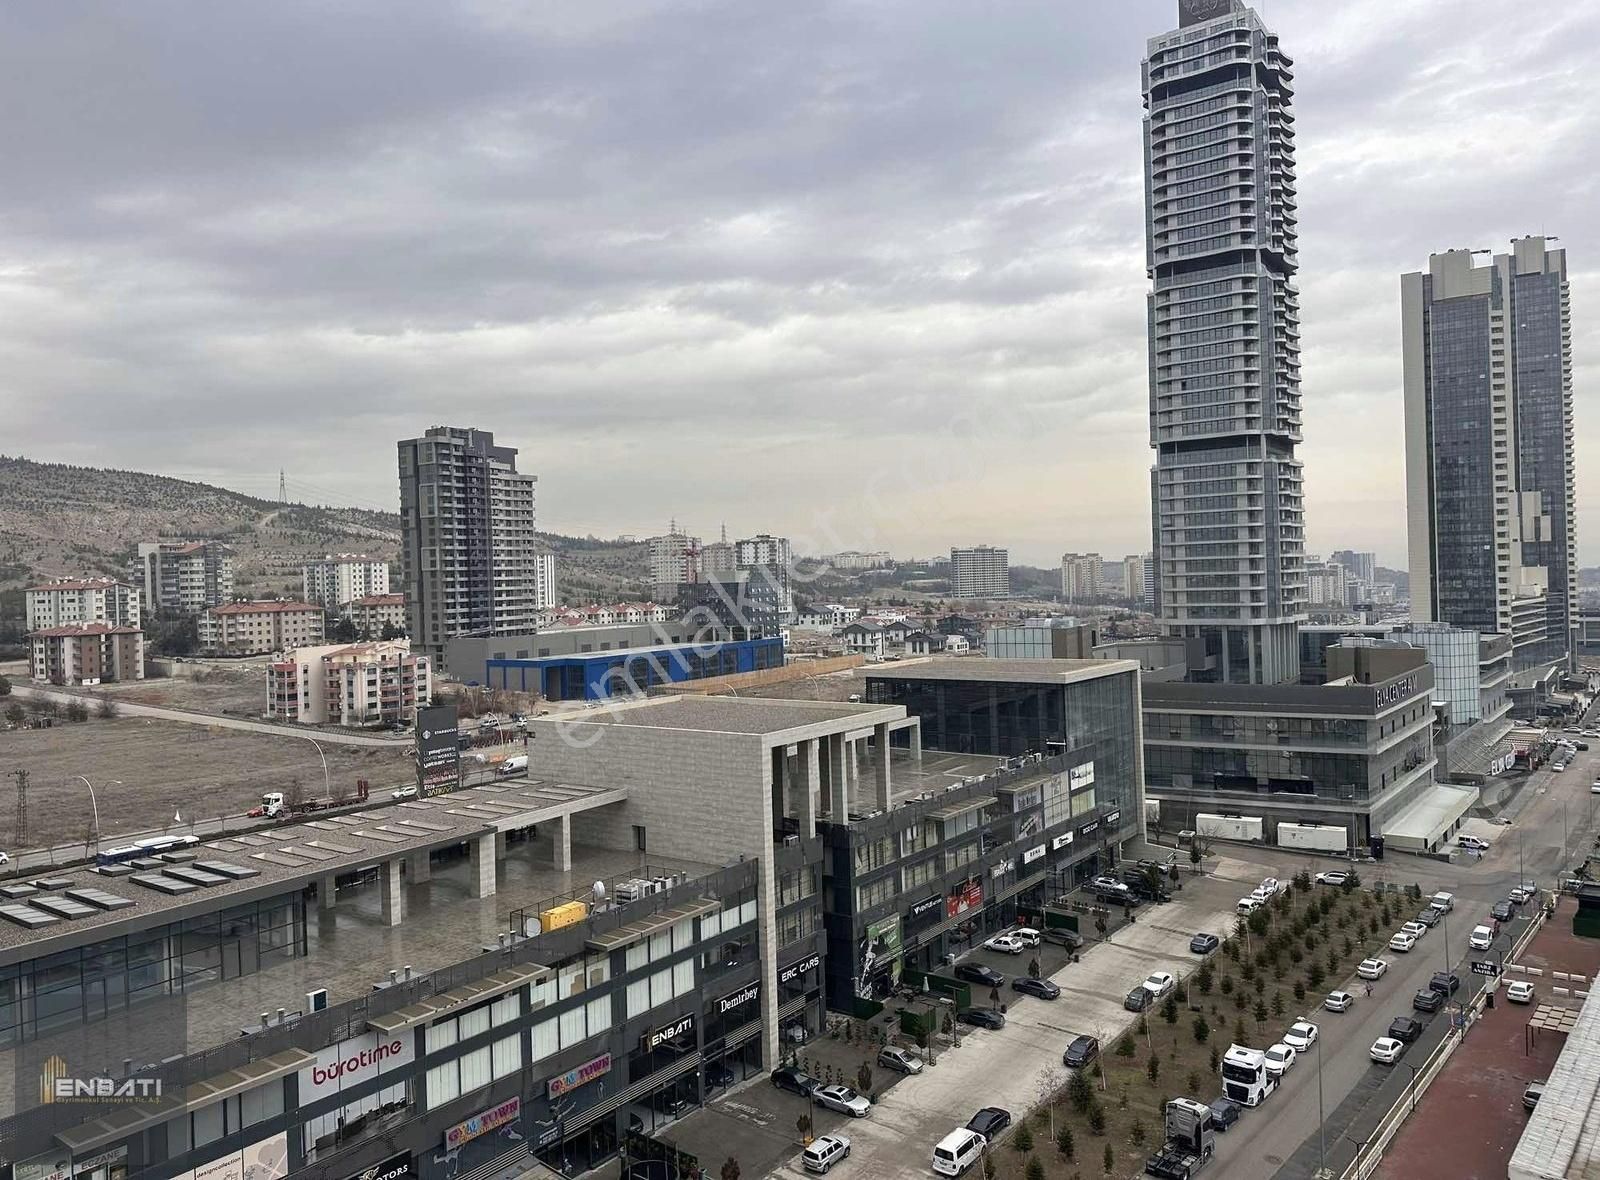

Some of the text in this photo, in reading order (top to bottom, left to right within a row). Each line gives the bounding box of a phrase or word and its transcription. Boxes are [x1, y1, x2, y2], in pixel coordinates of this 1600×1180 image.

[781, 957, 819, 982] ERC CARS
[720, 987, 758, 1013] Demirbey
[652, 1018, 692, 1046] ENBATI
[313, 1040, 402, 1085] bürotime
[81, 1149, 121, 1170] ECZANE
